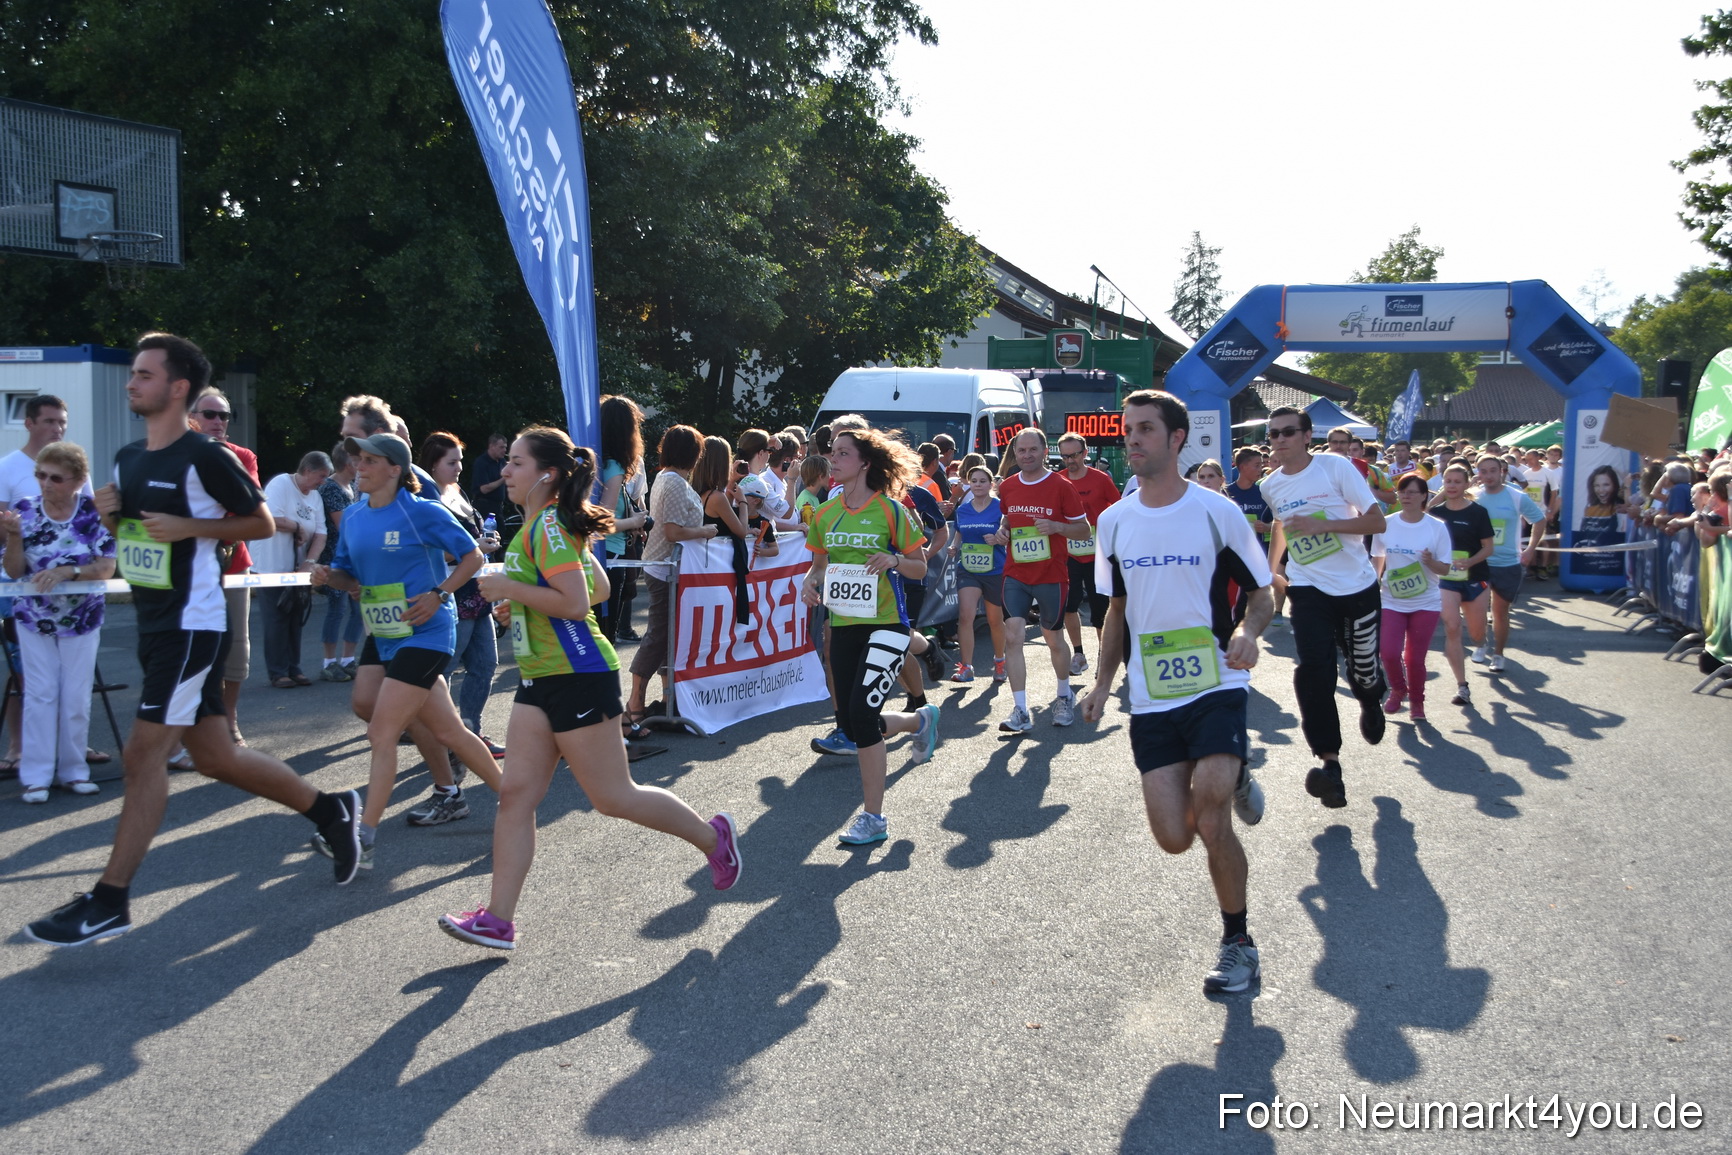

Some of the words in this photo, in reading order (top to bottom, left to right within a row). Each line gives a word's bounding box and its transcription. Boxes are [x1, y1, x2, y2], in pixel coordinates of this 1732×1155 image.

[1371, 316, 1456, 332] firmenlauf
[1215, 346, 1259, 357] Fischer
[1067, 414, 1126, 437] 00:00:5
[826, 532, 881, 549] BOCK
[1014, 539, 1045, 554] 1401
[123, 545, 164, 570] 1067
[964, 555, 990, 566] 1322
[1122, 555, 1200, 569] DELPHI
[828, 566, 868, 578] df-sport
[829, 582, 872, 601] 8926
[1392, 575, 1423, 593] 1301
[825, 601, 876, 610] www.df-sports.de
[365, 605, 404, 624] 1280
[1156, 654, 1203, 681] 283
[691, 660, 804, 708] www.meier-baustoffe.de
